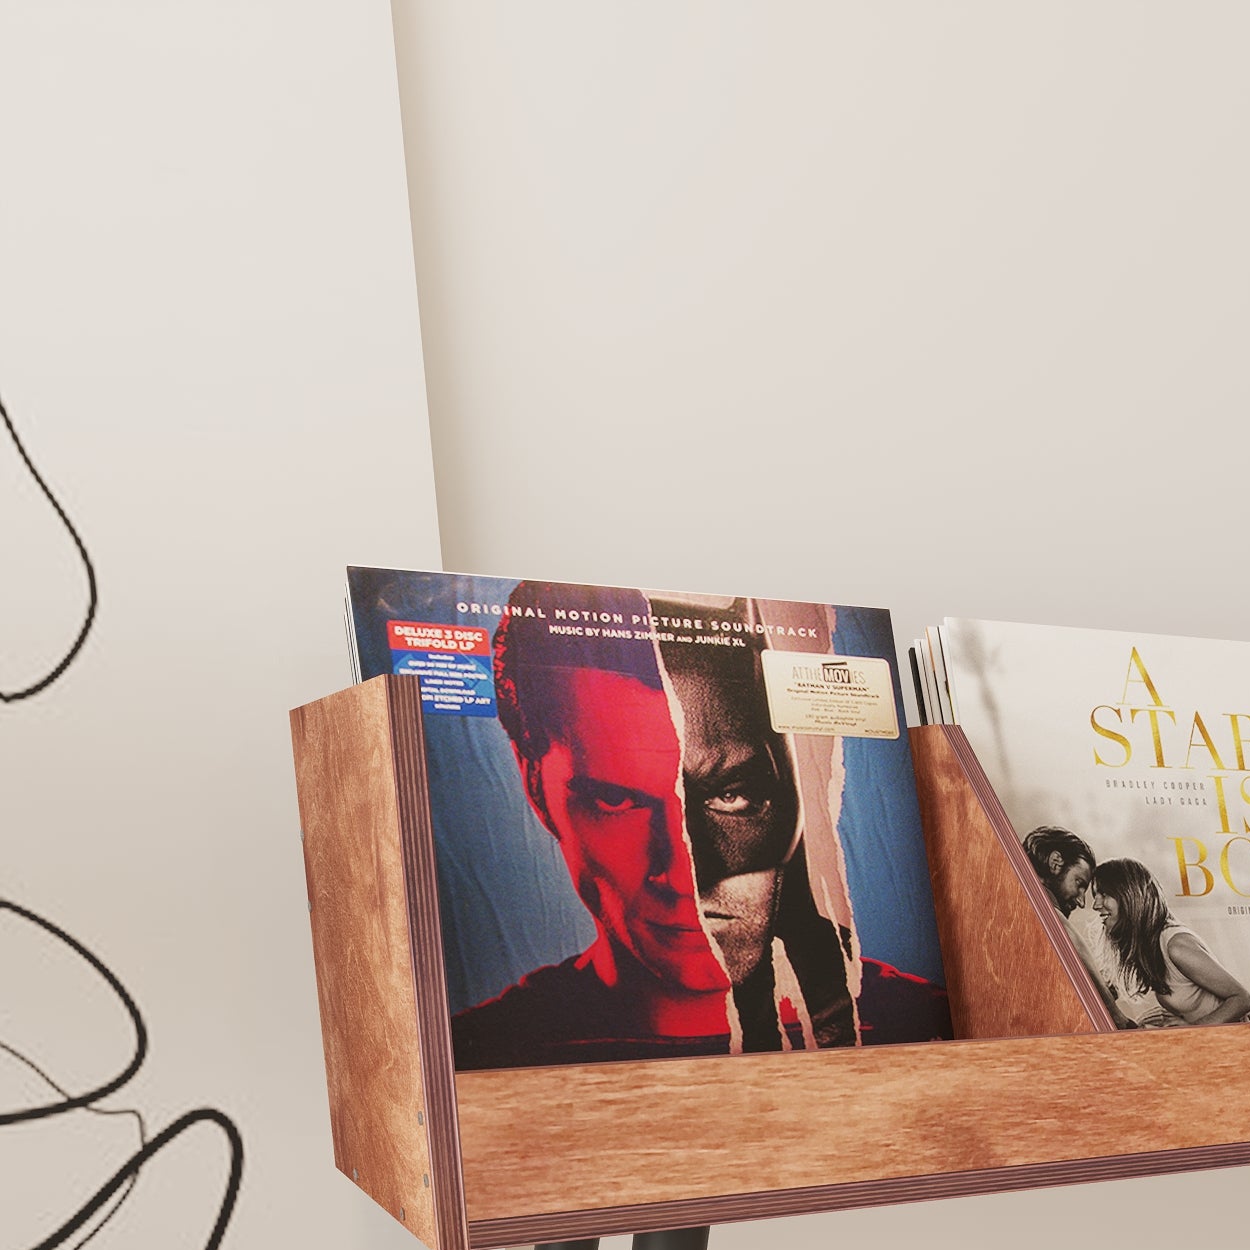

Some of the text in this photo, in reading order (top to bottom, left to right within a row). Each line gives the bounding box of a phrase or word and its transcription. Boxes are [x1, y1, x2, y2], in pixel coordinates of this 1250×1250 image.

[456, 602, 818, 638] ORIGINAL MOTION PICTURE SOUNDTRACK
[394, 625, 483, 642] DELUXE 3 DISC
[549, 624, 583, 636] MUSIC
[585, 627, 600, 637] BY
[601, 628, 632, 639] HANS
[634, 630, 675, 642] ZIMMER
[694, 634, 730, 646] JUNKIE
[732, 637, 746, 647] XL
[405, 636, 475, 651] TRIFOLD LP
[1117, 646, 1170, 707] A
[1106, 779, 1205, 790] BRADLEY COOPER
[1145, 796, 1207, 805] LADY GAGA
